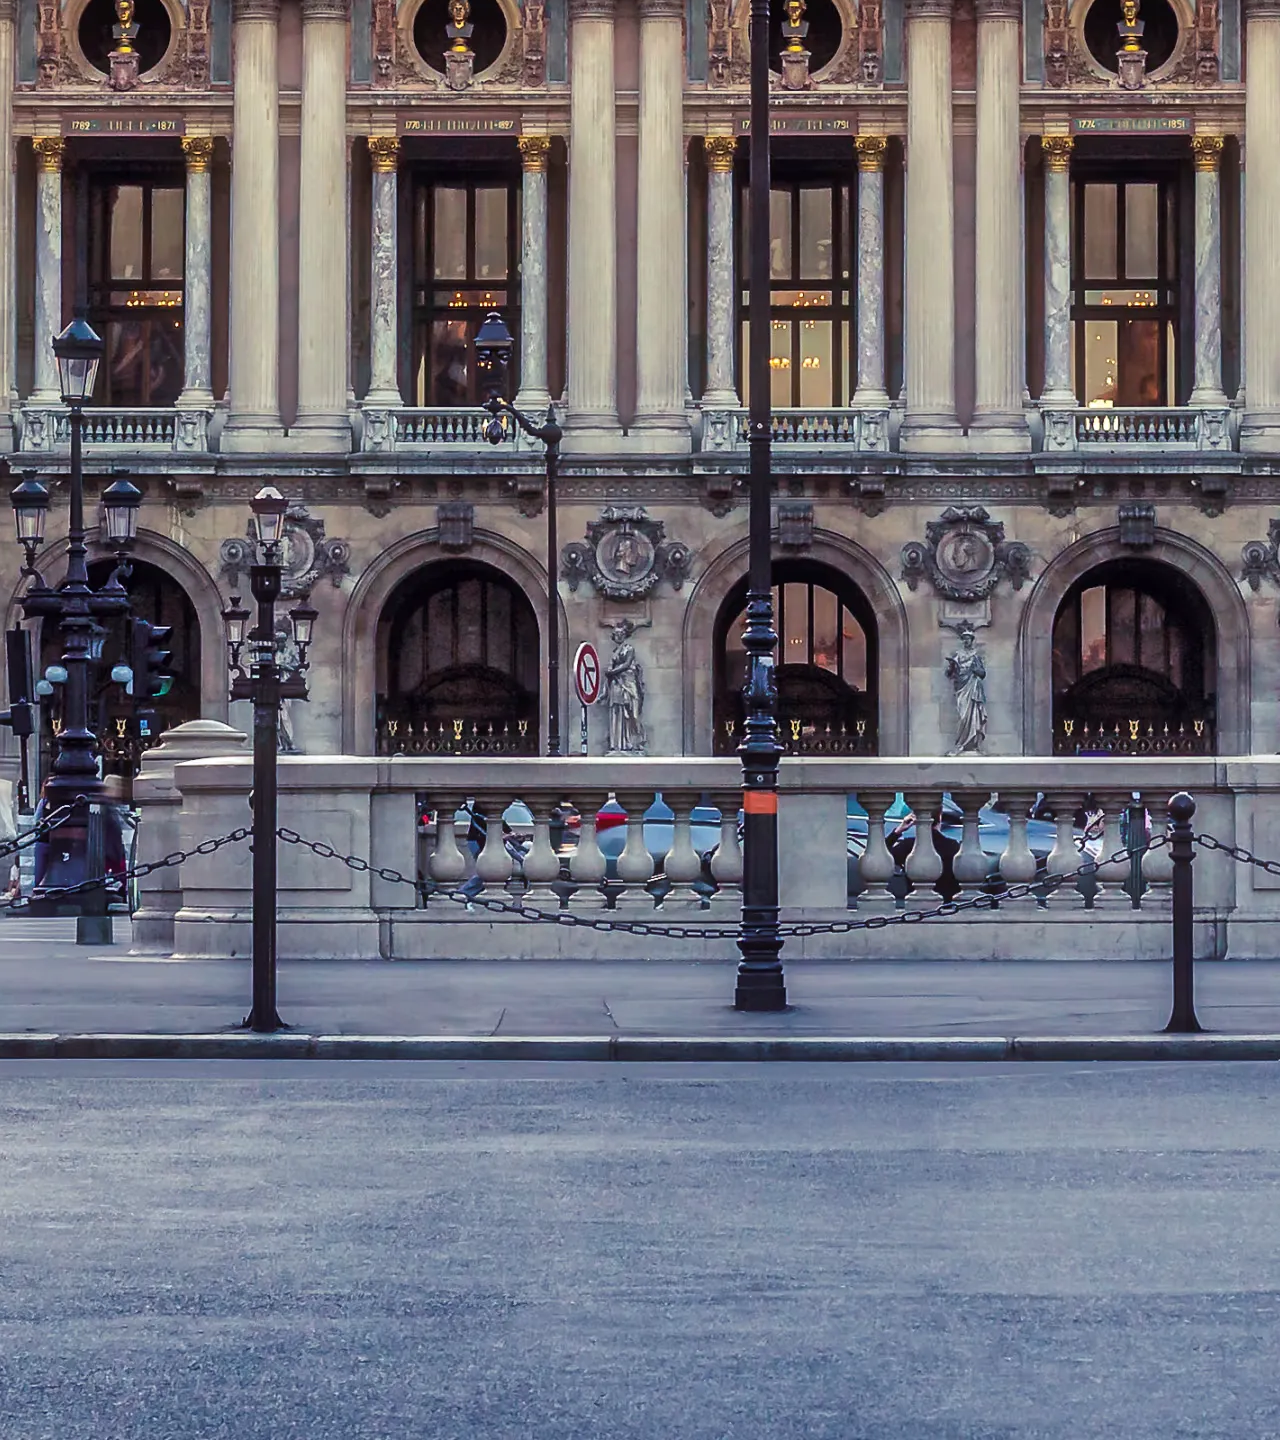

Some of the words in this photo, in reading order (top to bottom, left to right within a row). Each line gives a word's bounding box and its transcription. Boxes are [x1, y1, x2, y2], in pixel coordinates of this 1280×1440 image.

[157, 120, 175, 131] 1871
[833, 120, 849, 130] 1791
[1168, 119, 1185, 129] 1851
